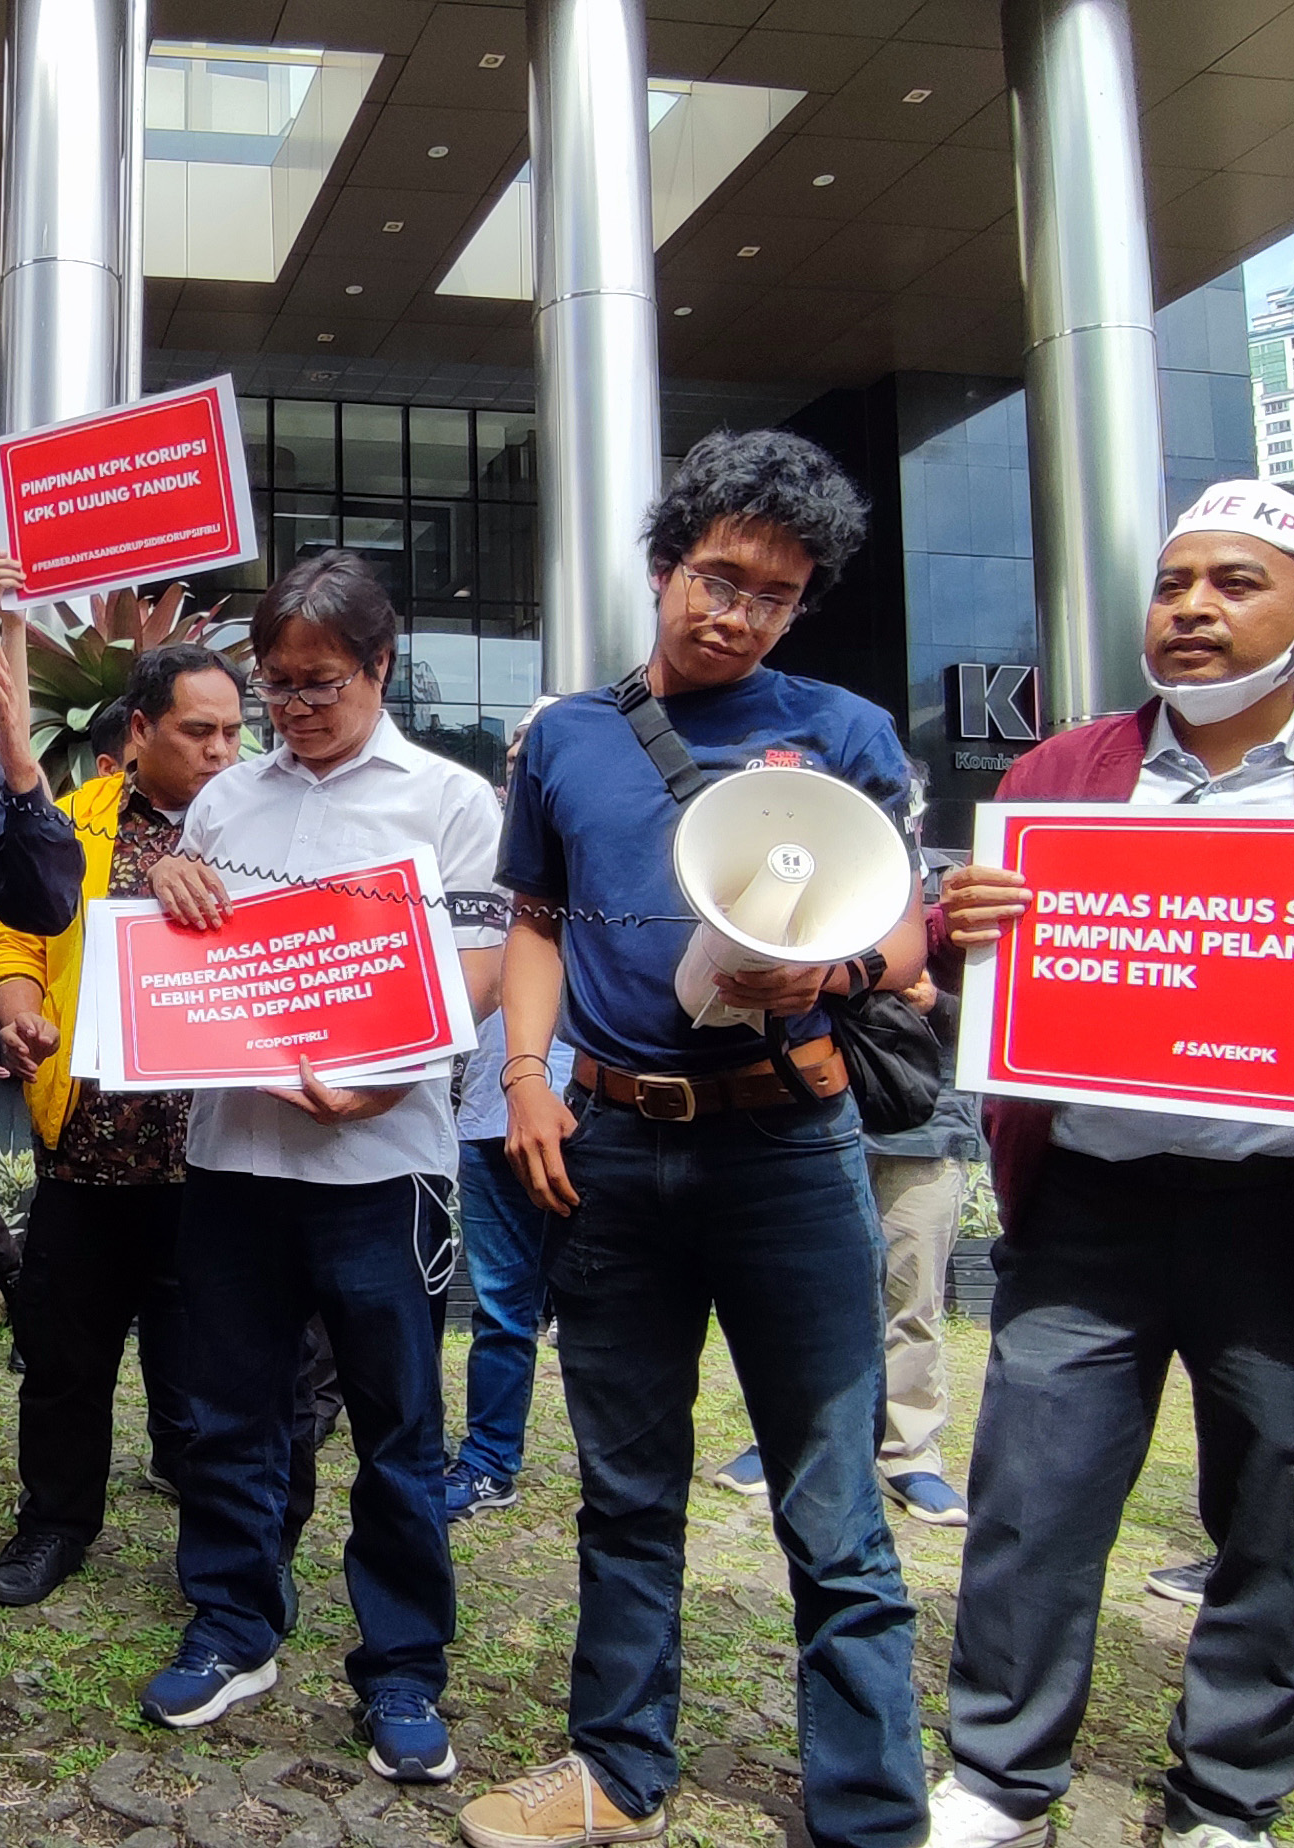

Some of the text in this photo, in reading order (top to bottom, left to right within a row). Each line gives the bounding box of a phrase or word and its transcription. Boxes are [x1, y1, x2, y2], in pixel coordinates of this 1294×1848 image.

[20, 438, 207, 498] PIMPINAN KPK KORUPSI
[23, 470, 202, 525] KPK DI UJUNG TANDUK
[31, 523, 221, 573] #PEMBERANTASANKORUPSIDIKORUPSIFIRLI
[955, 751, 1021, 770] Komis
[1036, 890, 1151, 918] DEWAS
[1159, 895, 1276, 923] HARUS
[206, 925, 336, 965] MASA DEPAN
[1034, 923, 1193, 955] PIMPINAN
[140, 931, 408, 990] PEMBERANTASAN KORUPSI
[1031, 955, 1198, 989] KODE ETIK
[150, 954, 406, 1008] LEBIH PENTING DARIPADA
[186, 982, 373, 1024] MASA DEPAN FIRLI
[246, 1029, 329, 1051] #COPOTFIRLI
[1172, 1040, 1277, 1064] #SAVEKPK
